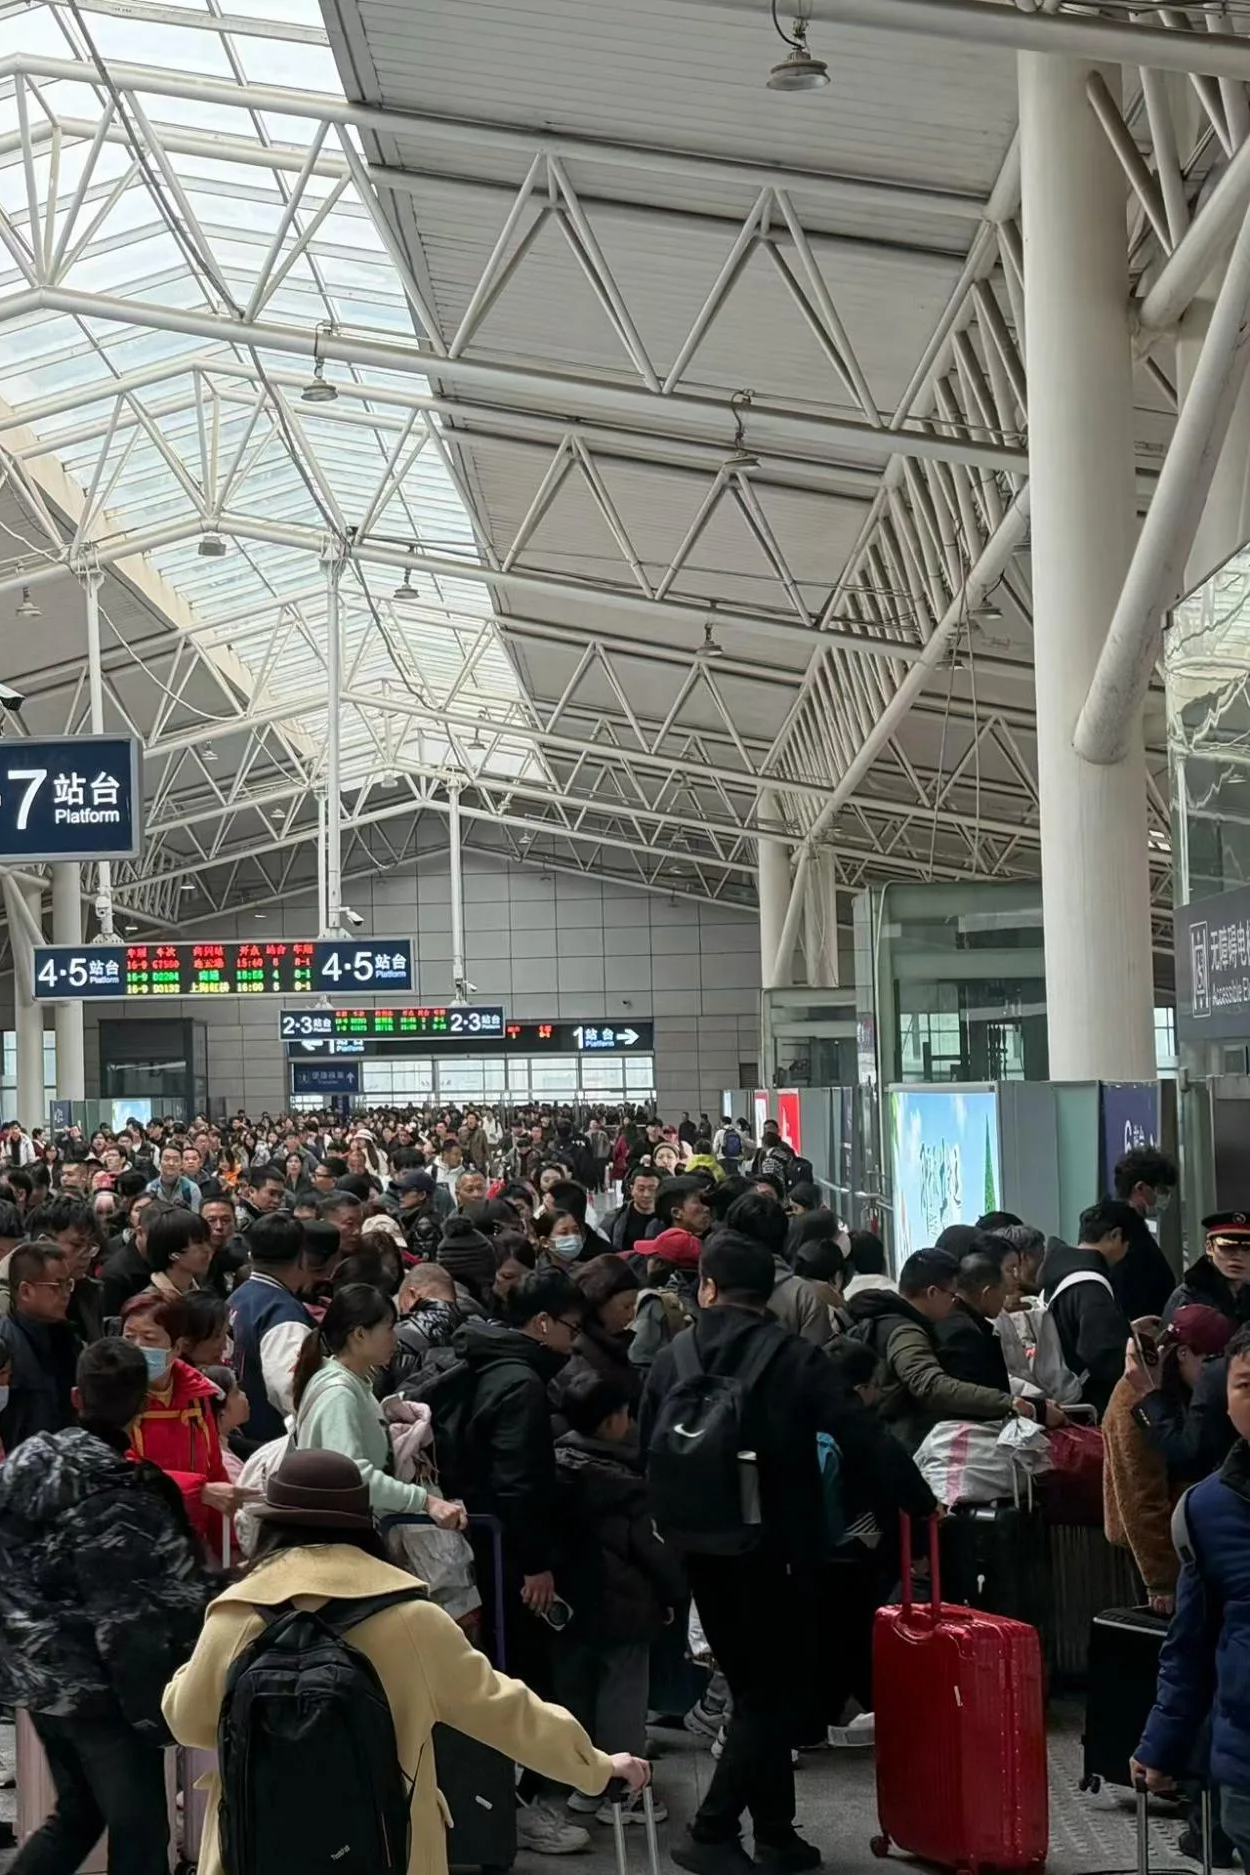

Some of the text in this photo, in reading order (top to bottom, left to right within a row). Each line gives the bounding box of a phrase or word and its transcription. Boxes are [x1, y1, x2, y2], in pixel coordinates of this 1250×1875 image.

[53, 771, 120, 806] 站台
[54, 807, 120, 824] Platform
[89, 960, 120, 976] 站台
[374, 953, 407, 970] 站台
[89, 976, 120, 984] Platform
[272, 969, 279, 980] 4
[313, 1017, 332, 1028] 站台
[481, 1014, 501, 1025] 站台
[573, 1026, 583, 1049] 1
[585, 1027, 614, 1040] 站台
